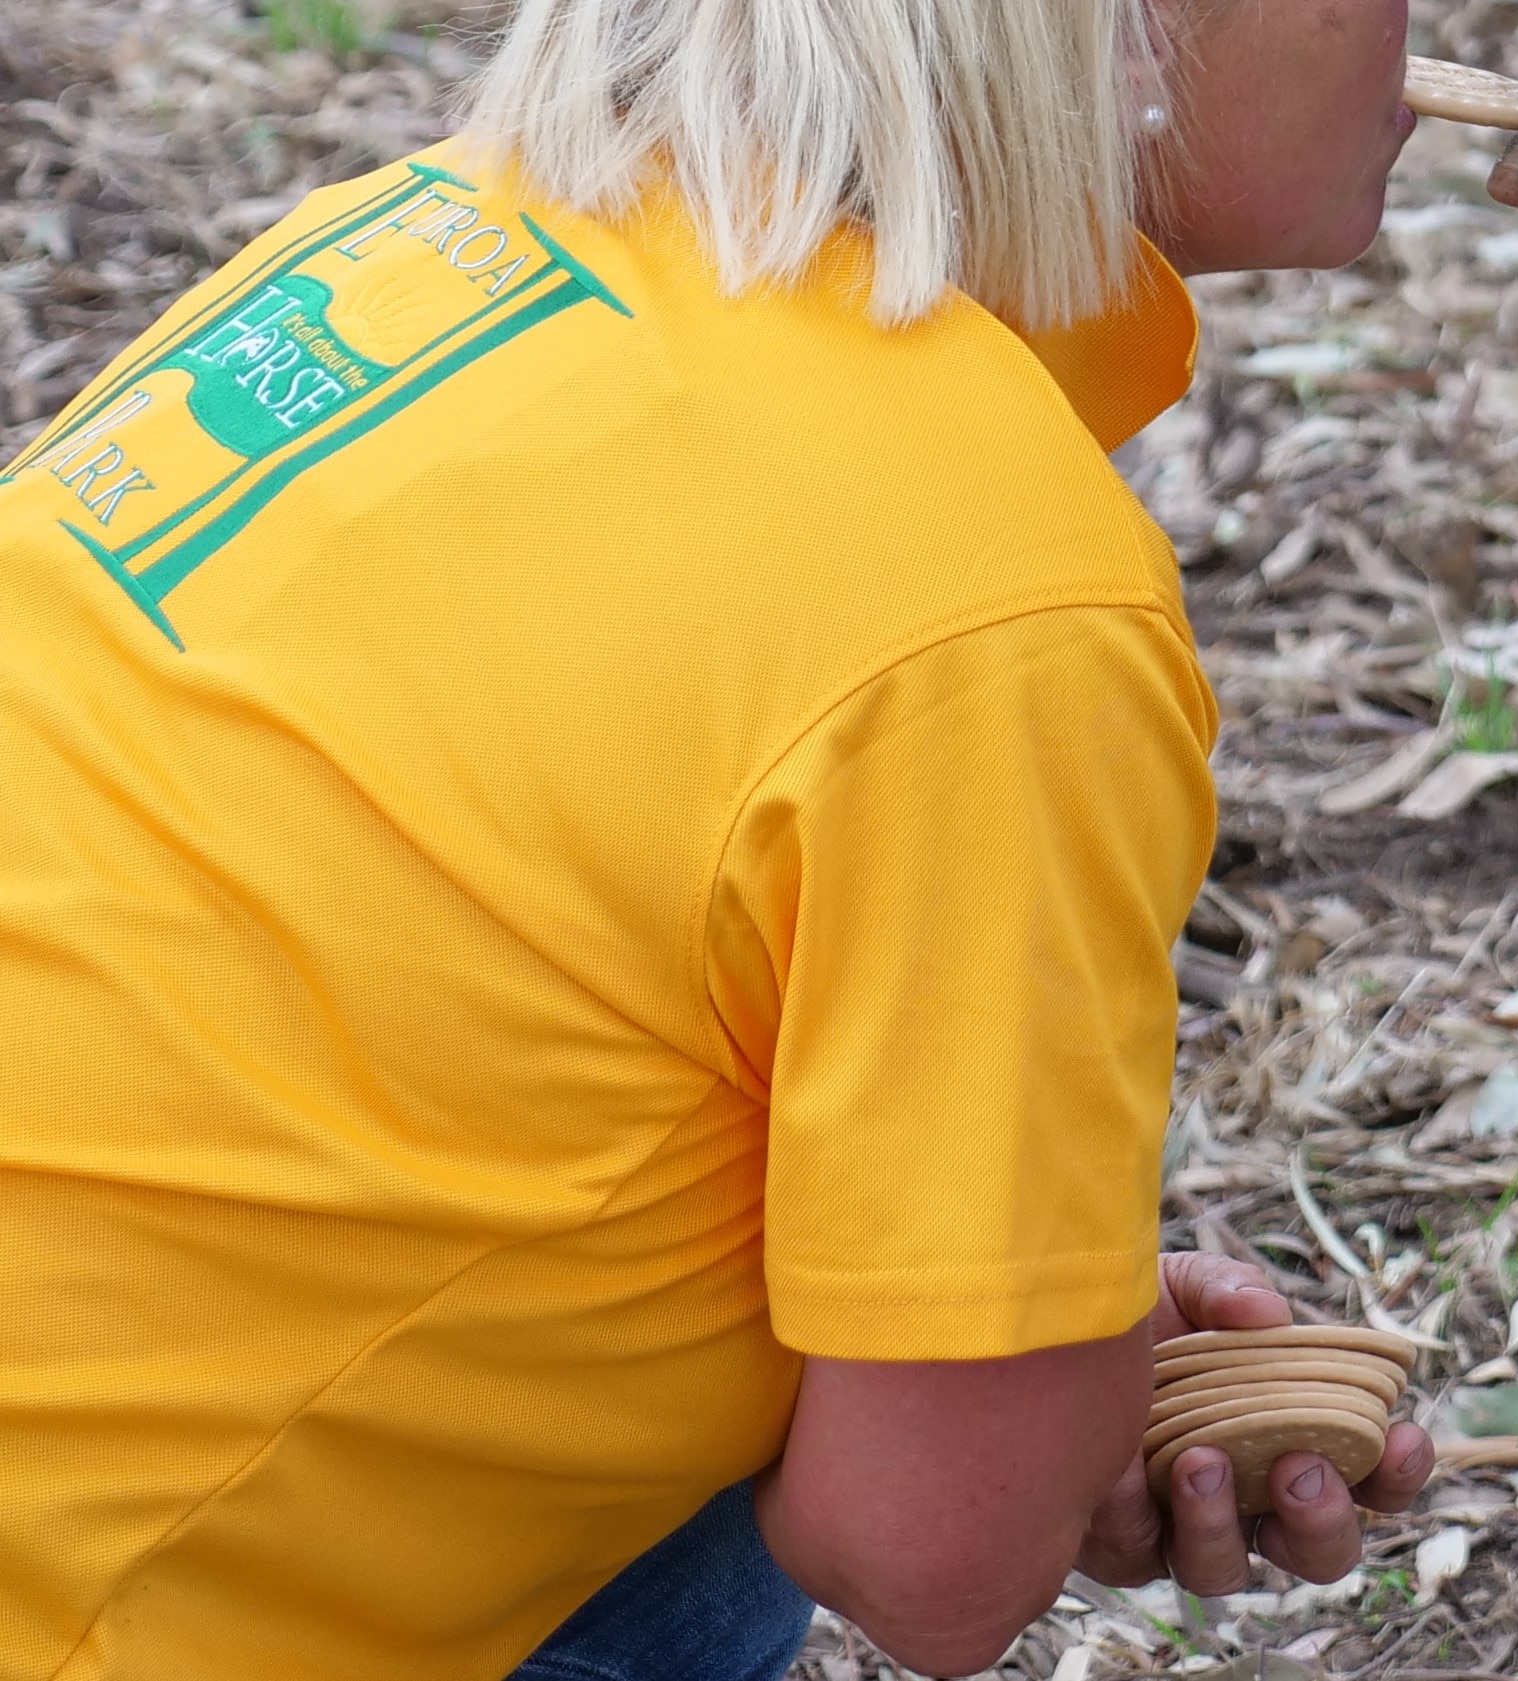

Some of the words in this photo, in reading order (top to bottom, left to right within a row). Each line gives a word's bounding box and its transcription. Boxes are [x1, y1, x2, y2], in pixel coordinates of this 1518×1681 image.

[334, 188, 530, 297] EUROA
[294, 326, 325, 342] all
[184, 284, 345, 428] HORSE
[307, 338, 352, 372] about
[339, 365, 368, 391] the
